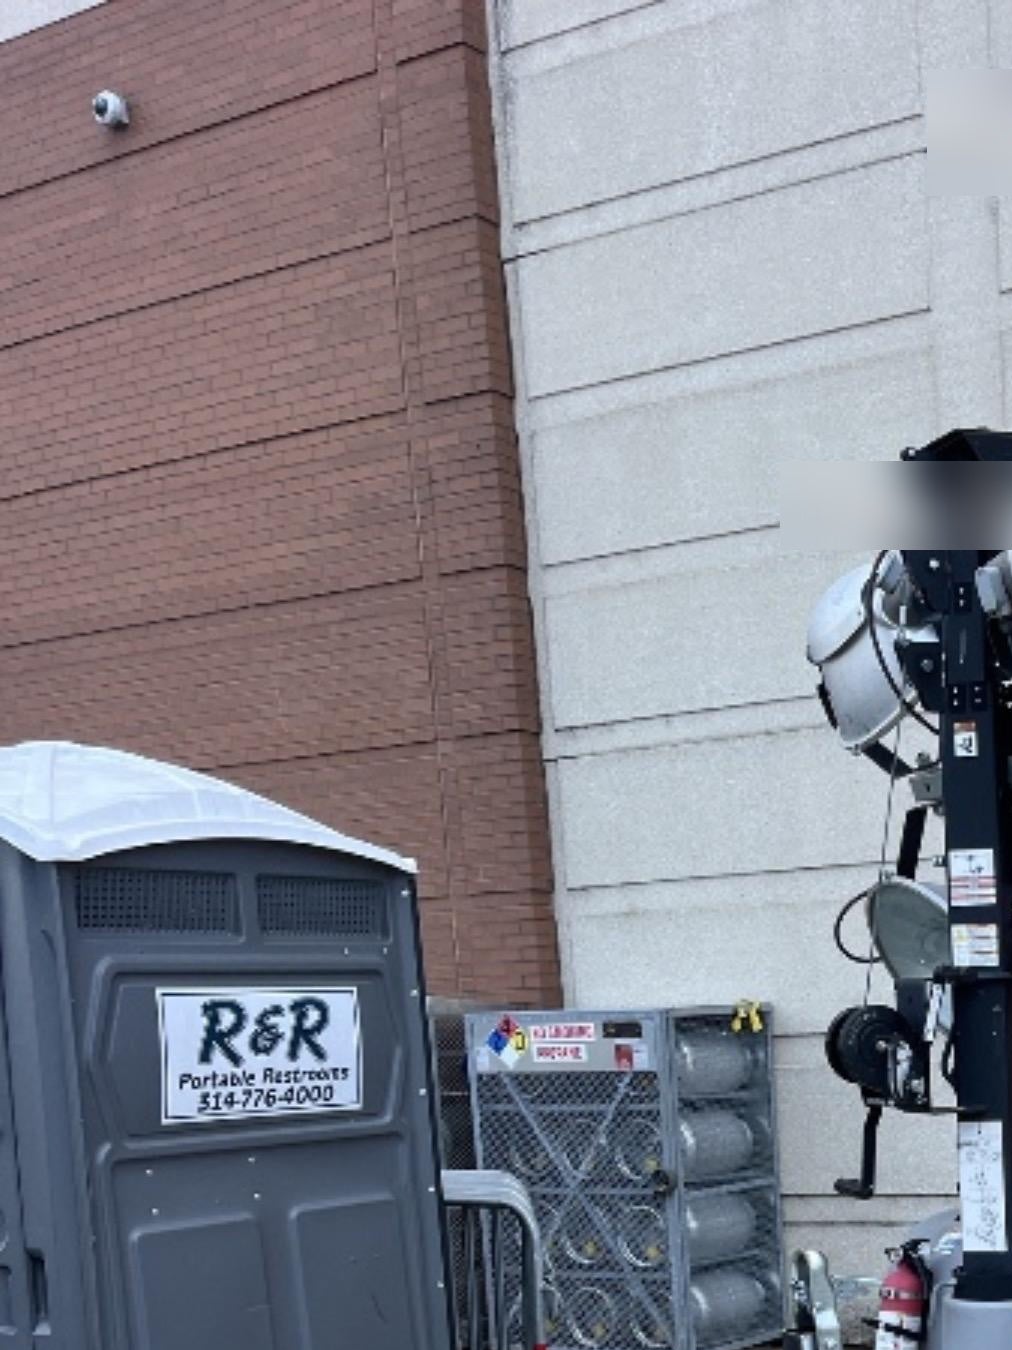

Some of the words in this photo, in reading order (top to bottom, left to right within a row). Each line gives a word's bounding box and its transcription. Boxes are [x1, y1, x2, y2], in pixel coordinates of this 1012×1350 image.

[198, 997, 329, 1067] R&R
[178, 1070, 256, 1091] Portable
[198, 1086, 334, 1111] 314-776-4000
